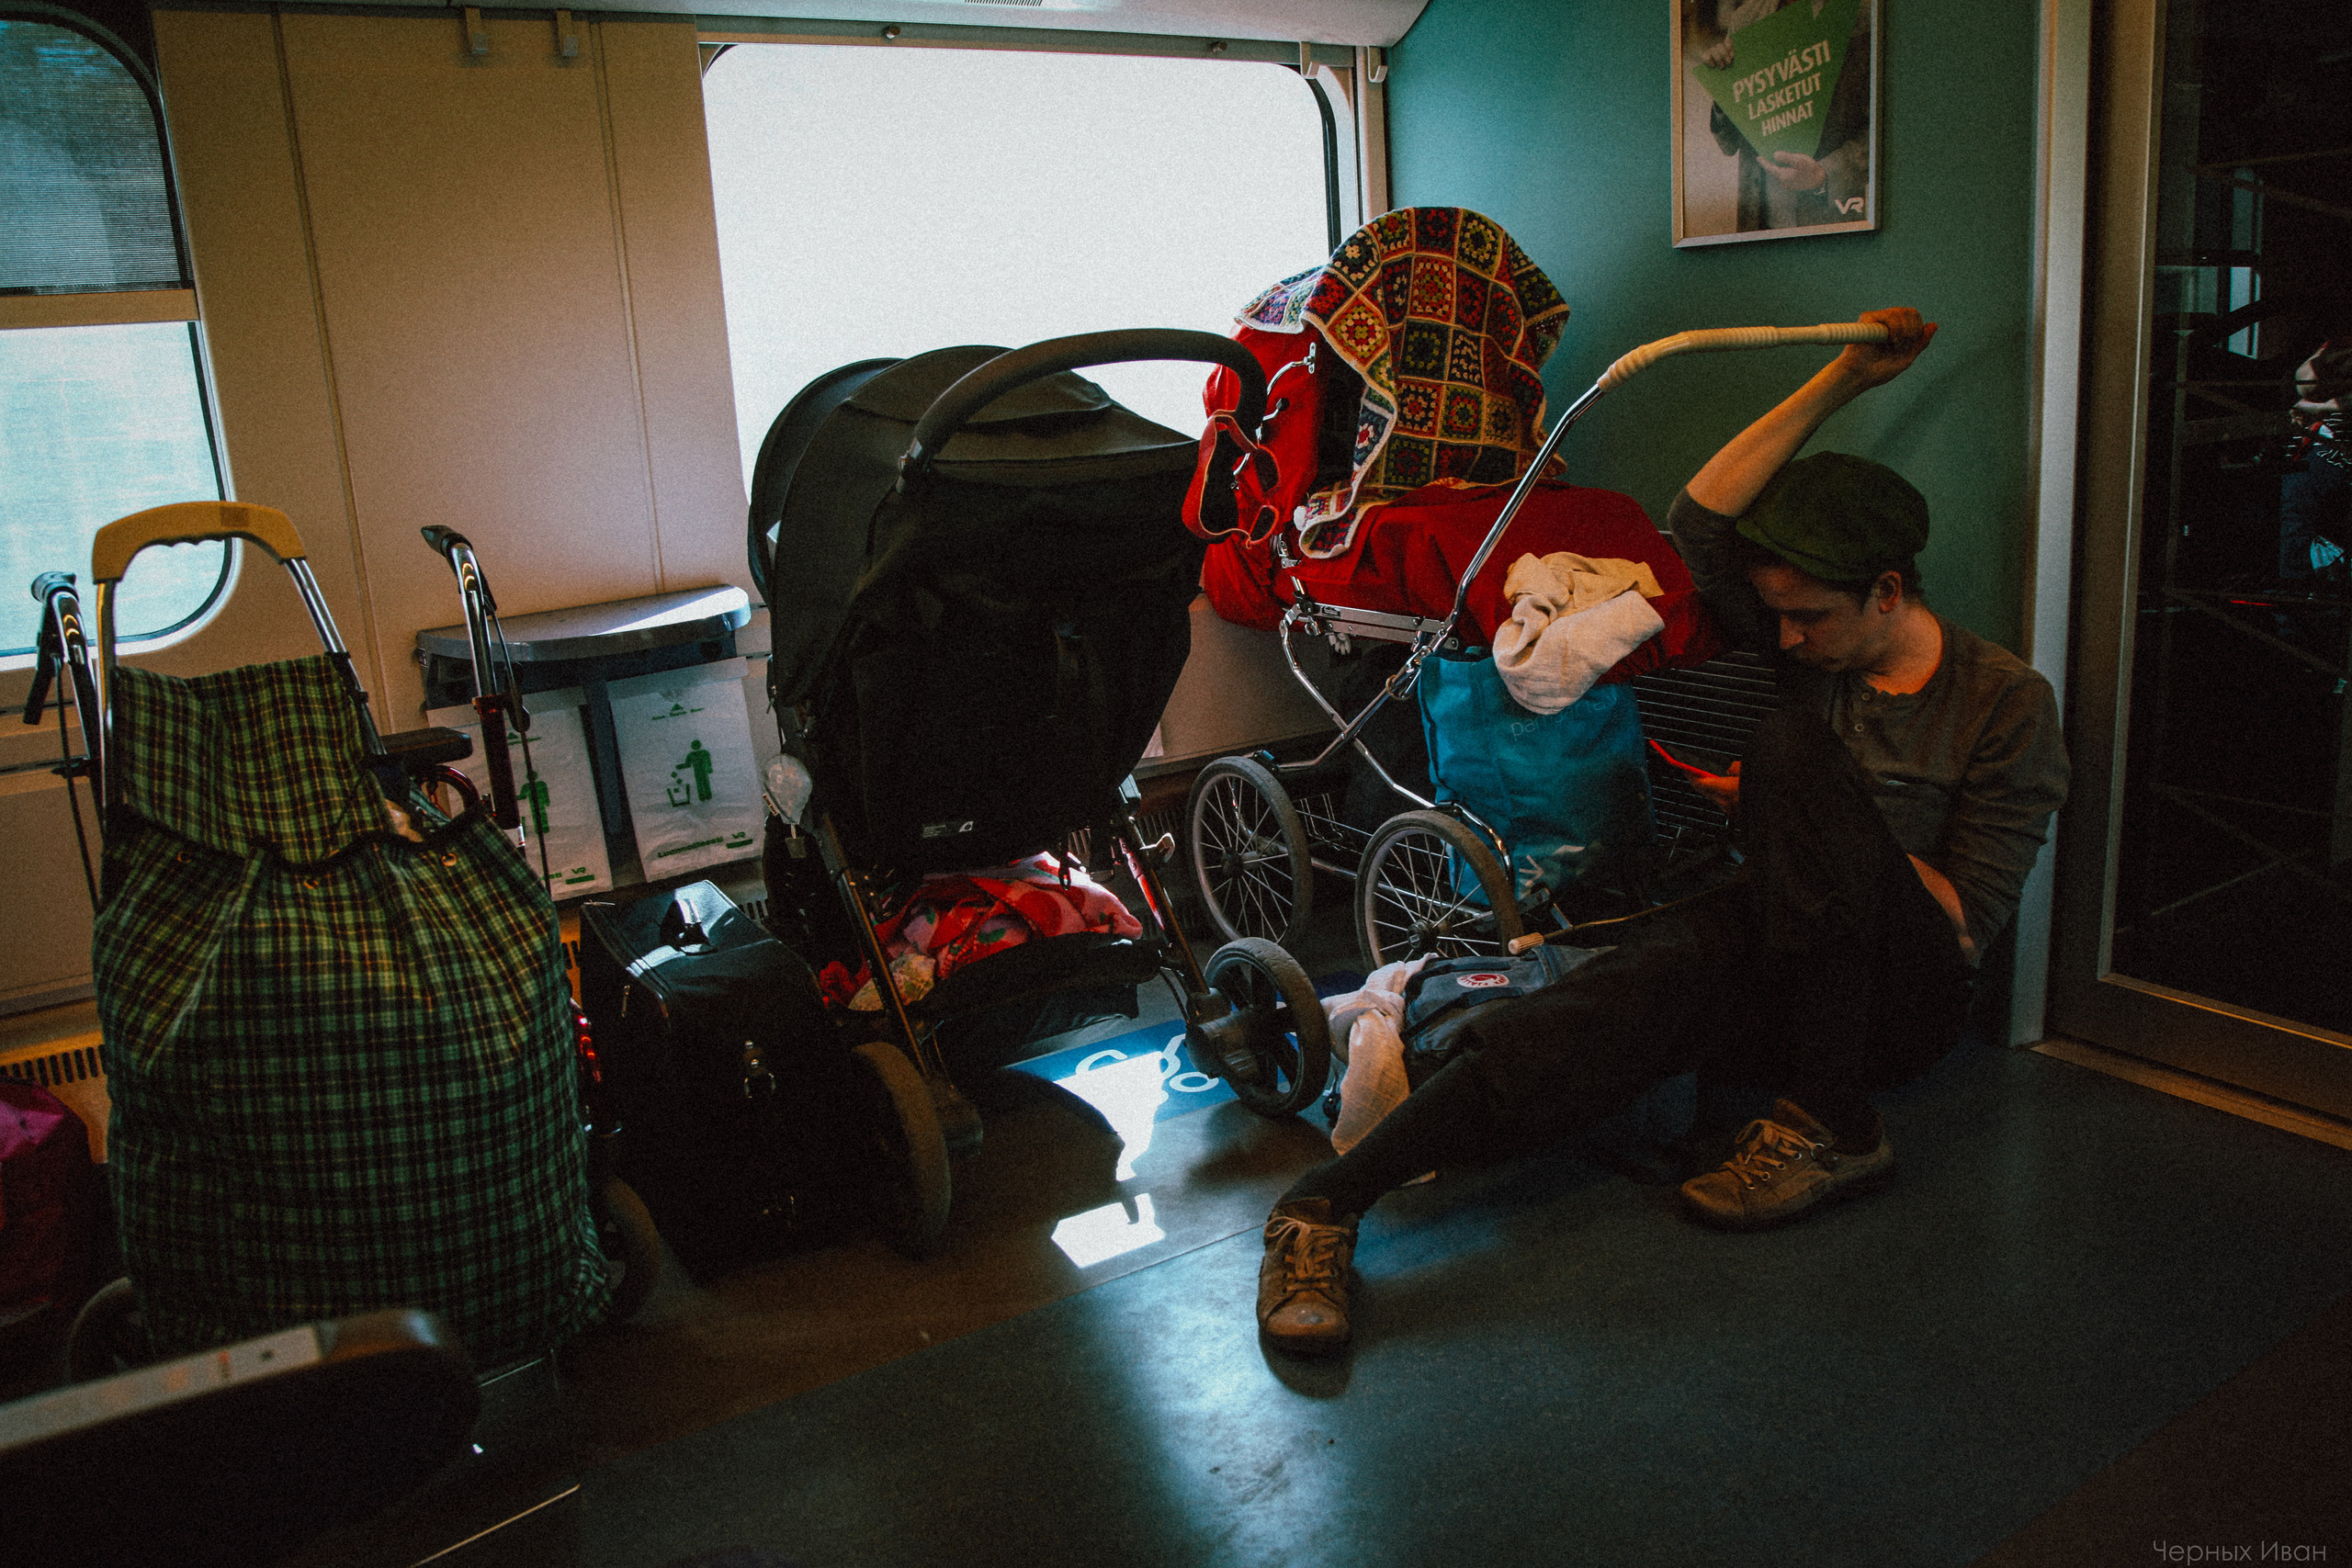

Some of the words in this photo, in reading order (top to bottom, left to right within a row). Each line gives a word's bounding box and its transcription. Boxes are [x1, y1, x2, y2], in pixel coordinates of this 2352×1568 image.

[1733, 39, 1831, 103] PYSYVÄSTI
[1748, 73, 1822, 120] LASKETUT
[1761, 100, 1814, 137] HINNAT
[1834, 197, 1865, 214] VR
